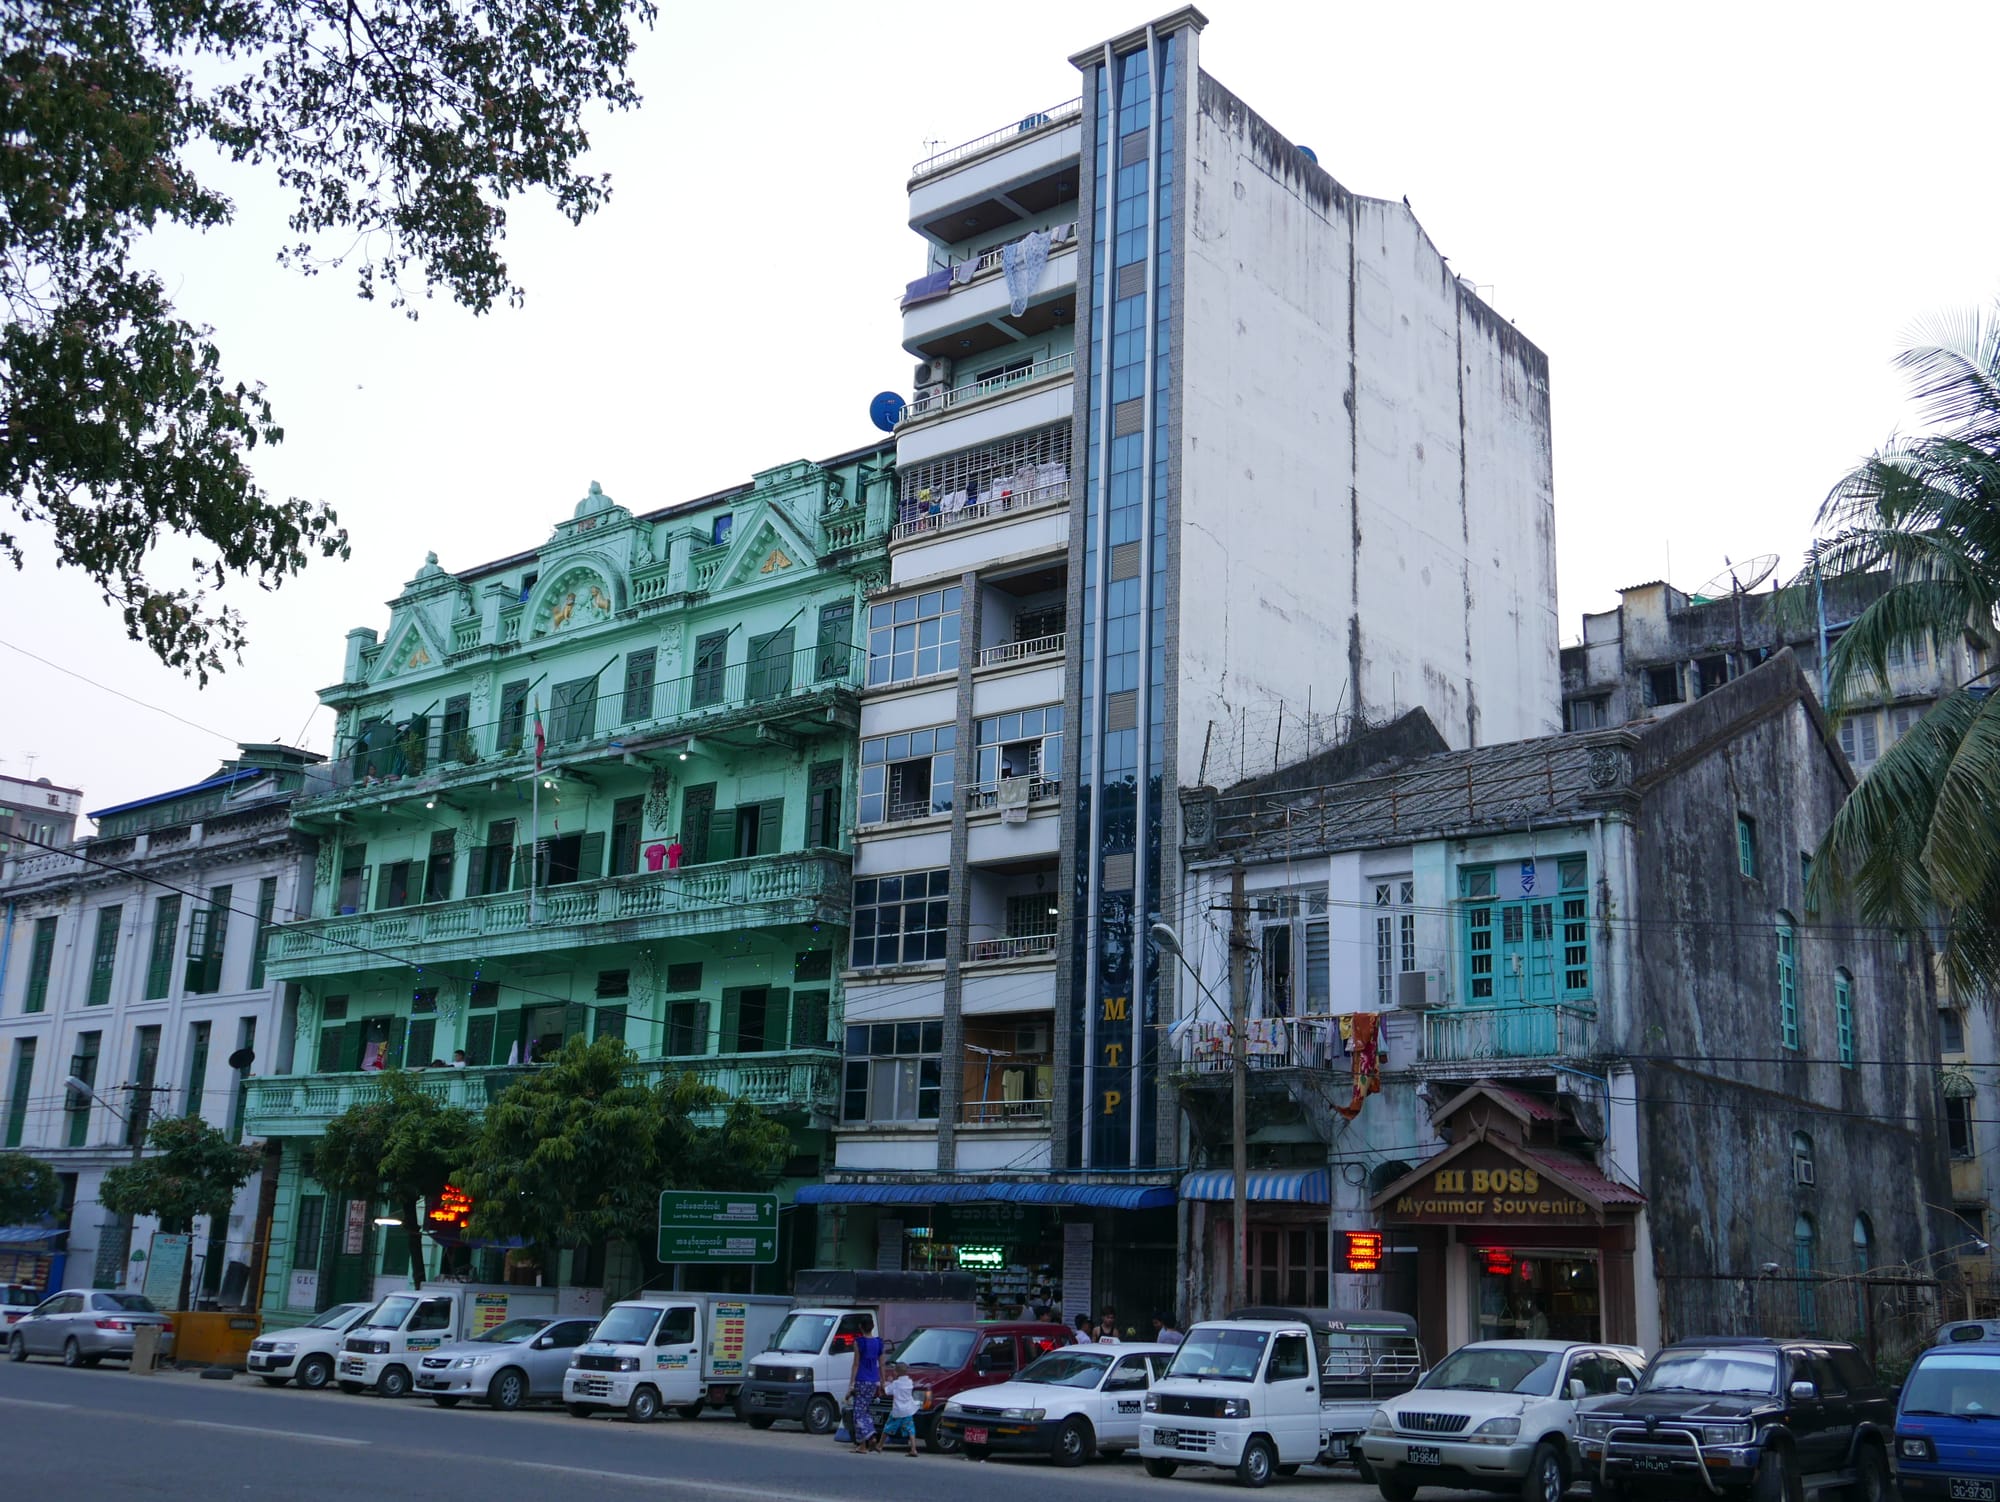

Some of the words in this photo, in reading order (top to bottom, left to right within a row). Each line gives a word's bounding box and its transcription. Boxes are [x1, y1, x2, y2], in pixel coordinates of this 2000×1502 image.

[1434, 1169, 1465, 1194] HI
[1472, 1169, 1540, 1194] BOSS
[1397, 1198, 1485, 1217] Myanmar
[1493, 1198, 1587, 1215] Souvenirs
[1953, 1485, 1993, 1499] 3C-9730
